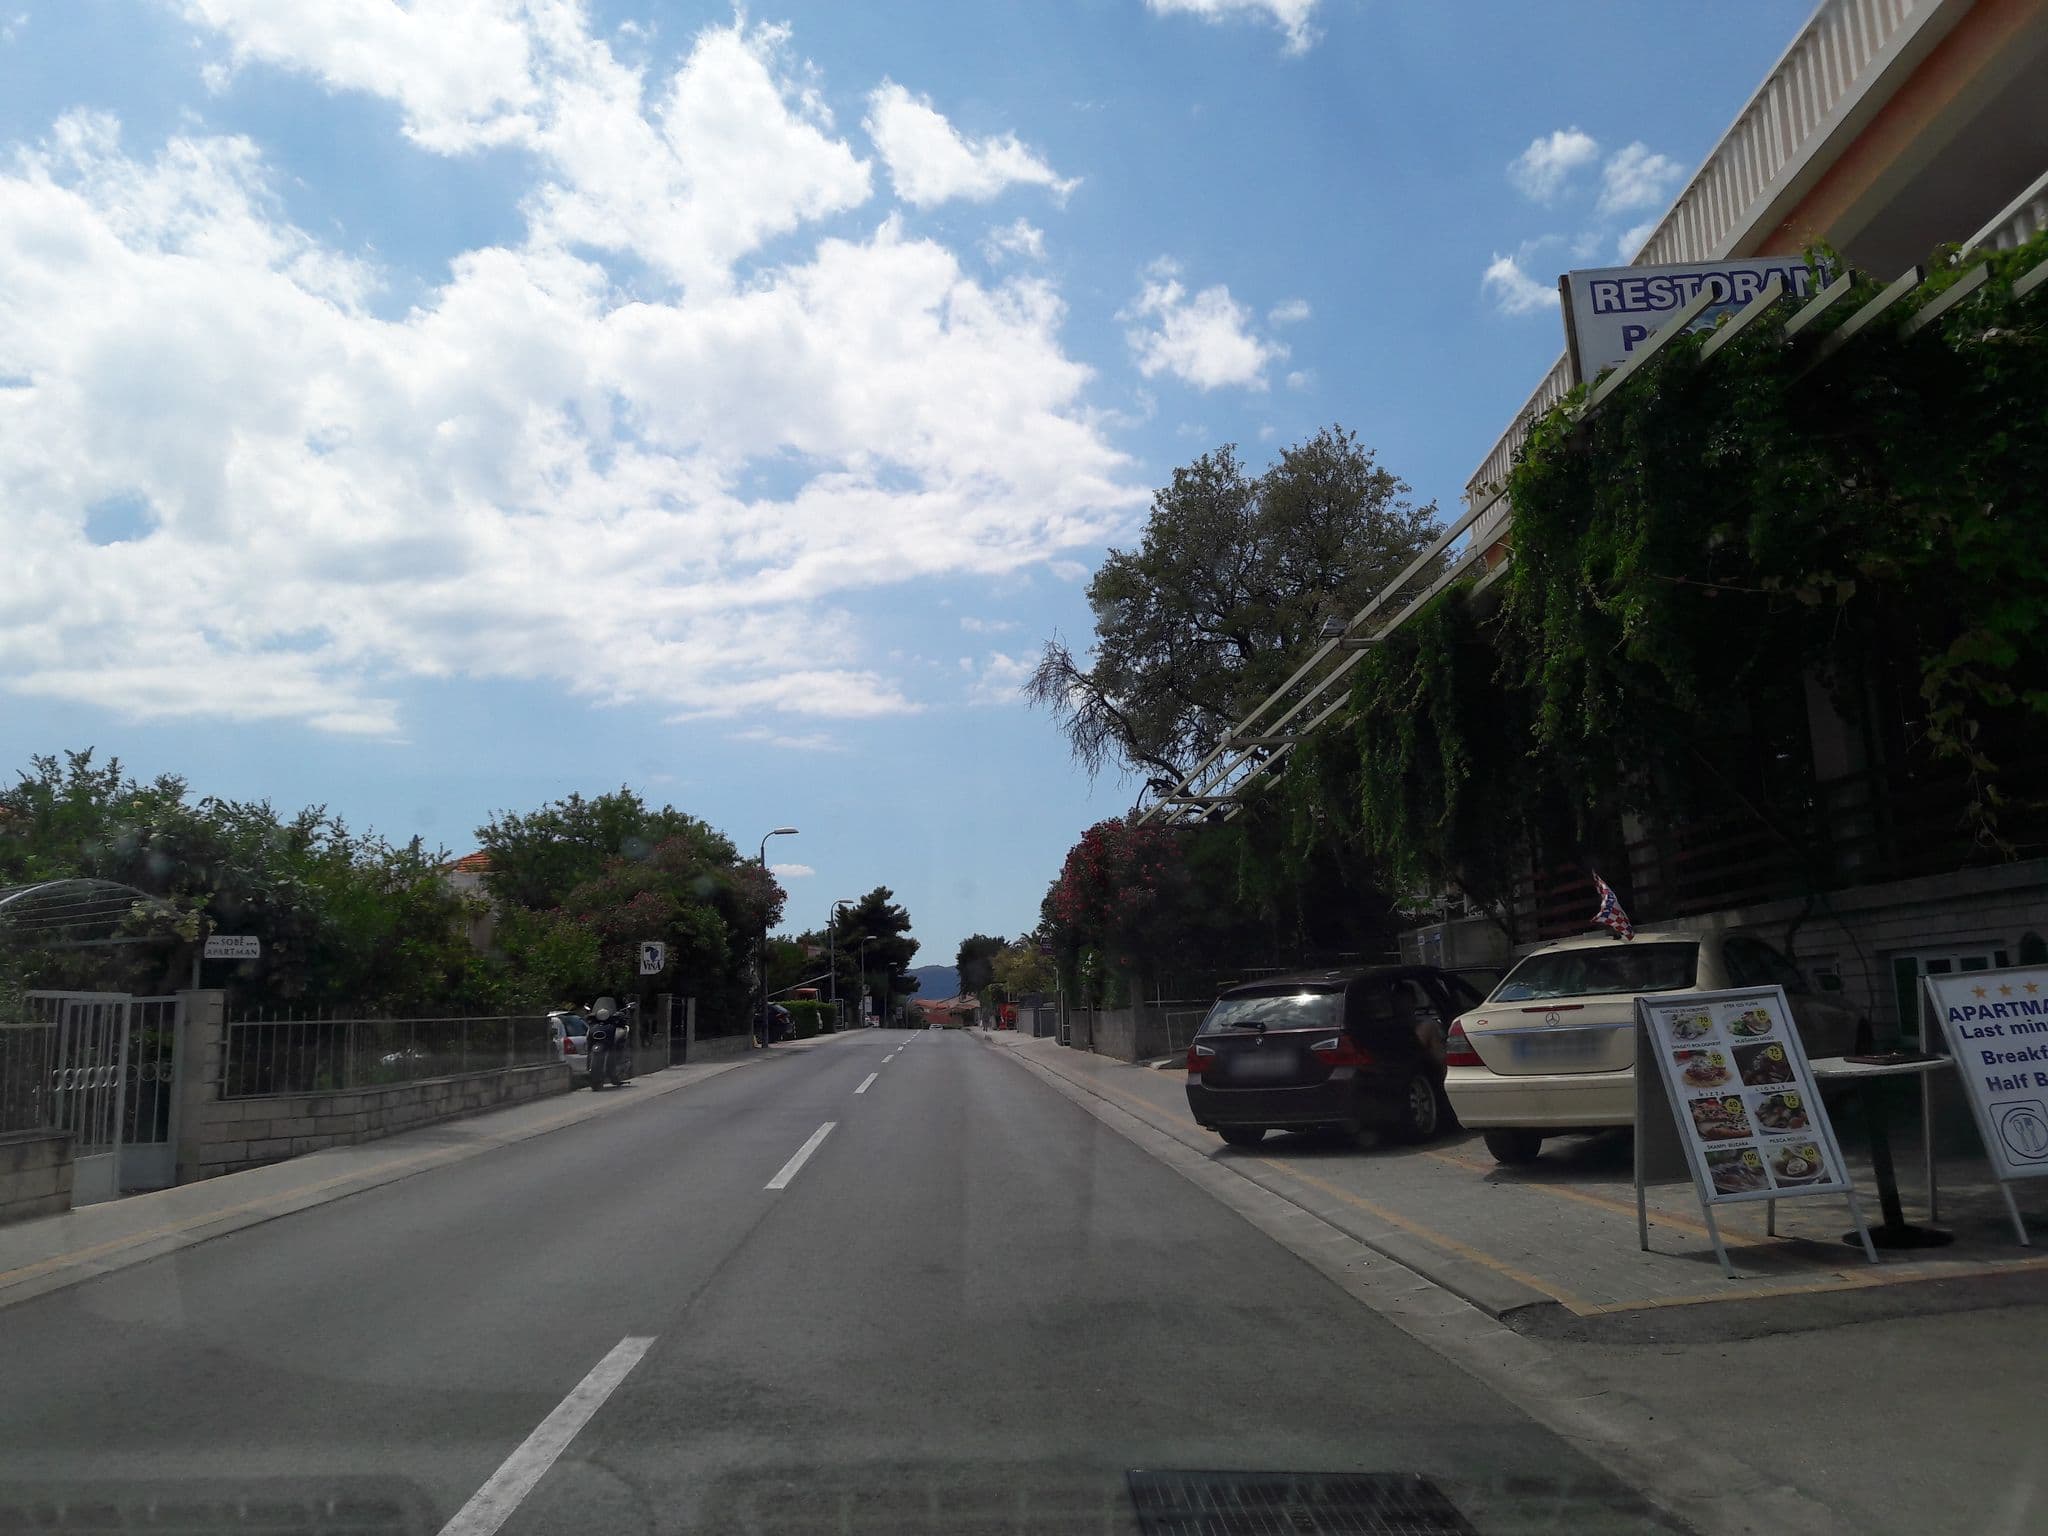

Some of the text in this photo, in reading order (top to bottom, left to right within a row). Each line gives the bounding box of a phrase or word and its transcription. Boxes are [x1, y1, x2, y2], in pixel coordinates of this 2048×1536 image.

[1959, 1019, 2048, 1039] Last min
[1985, 1073, 2028, 1092] Half
[1744, 1153, 1757, 1162] 100
